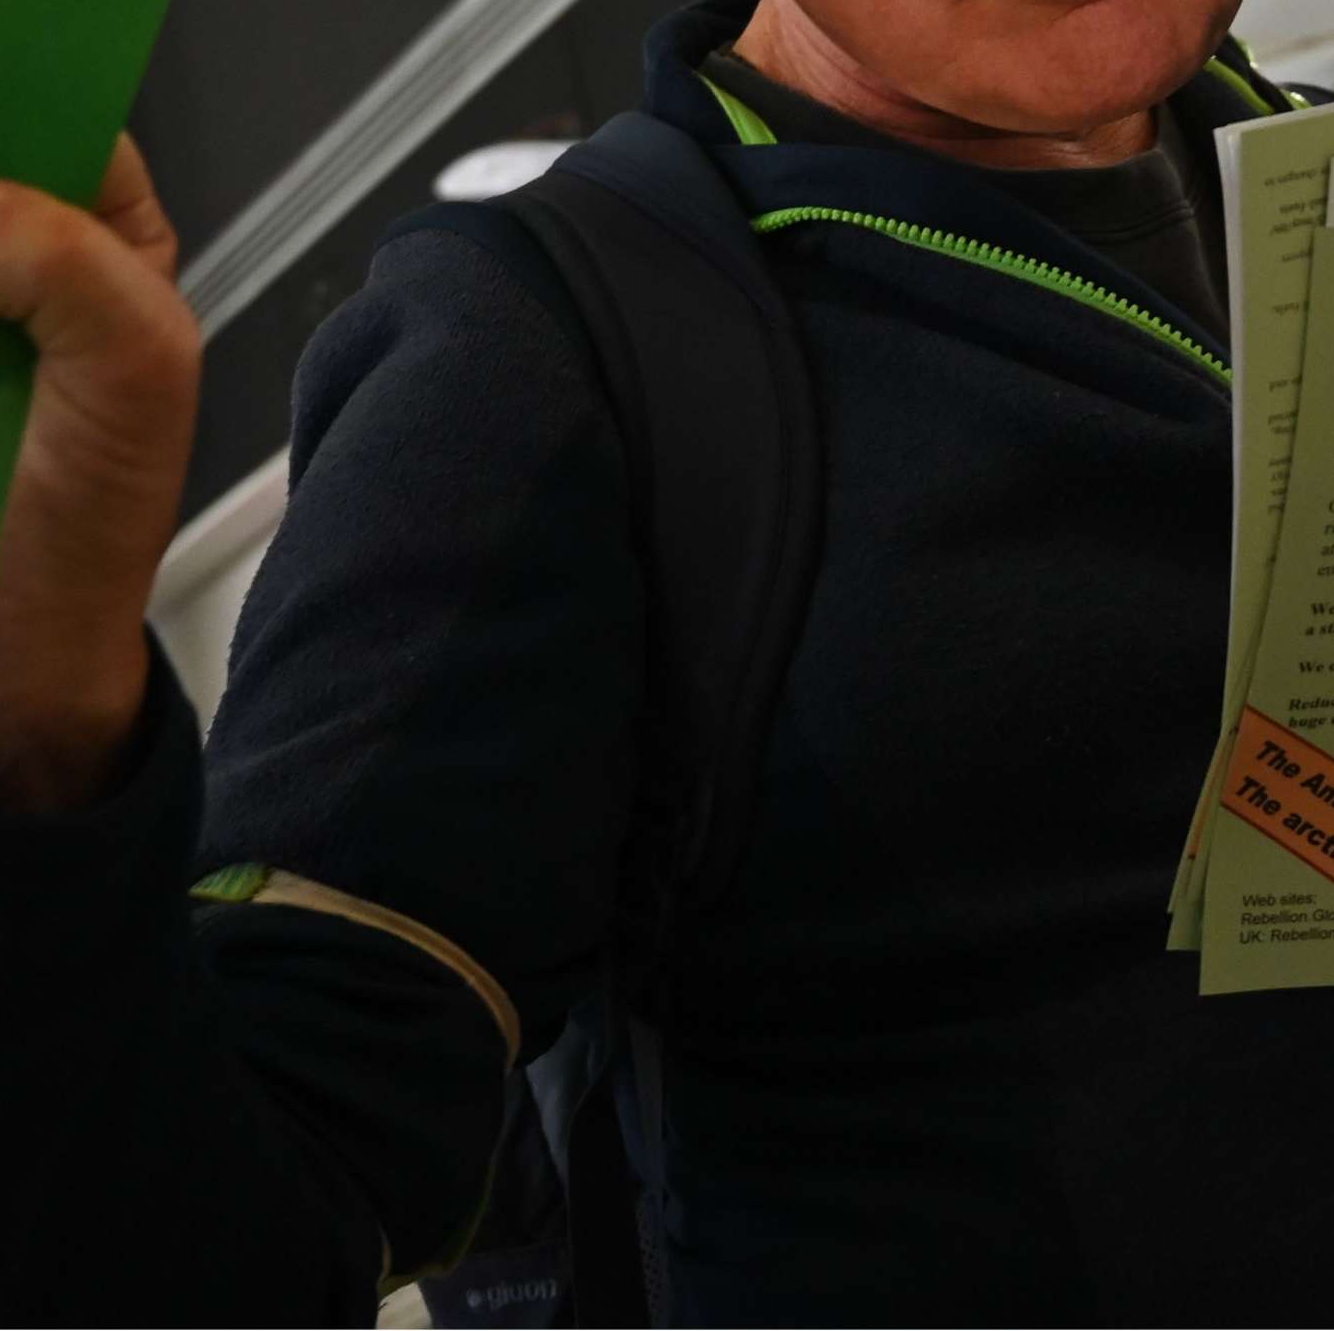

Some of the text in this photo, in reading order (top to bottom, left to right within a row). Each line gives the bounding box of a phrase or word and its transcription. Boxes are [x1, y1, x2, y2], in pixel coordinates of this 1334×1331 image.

[1303, 625, 1314, 636] a
[1298, 659, 1324, 673] We
[1287, 712, 1325, 731] huge
[1255, 740, 1302, 778] The
[1235, 776, 1282, 816] The
[1241, 893, 1276, 908] Web
